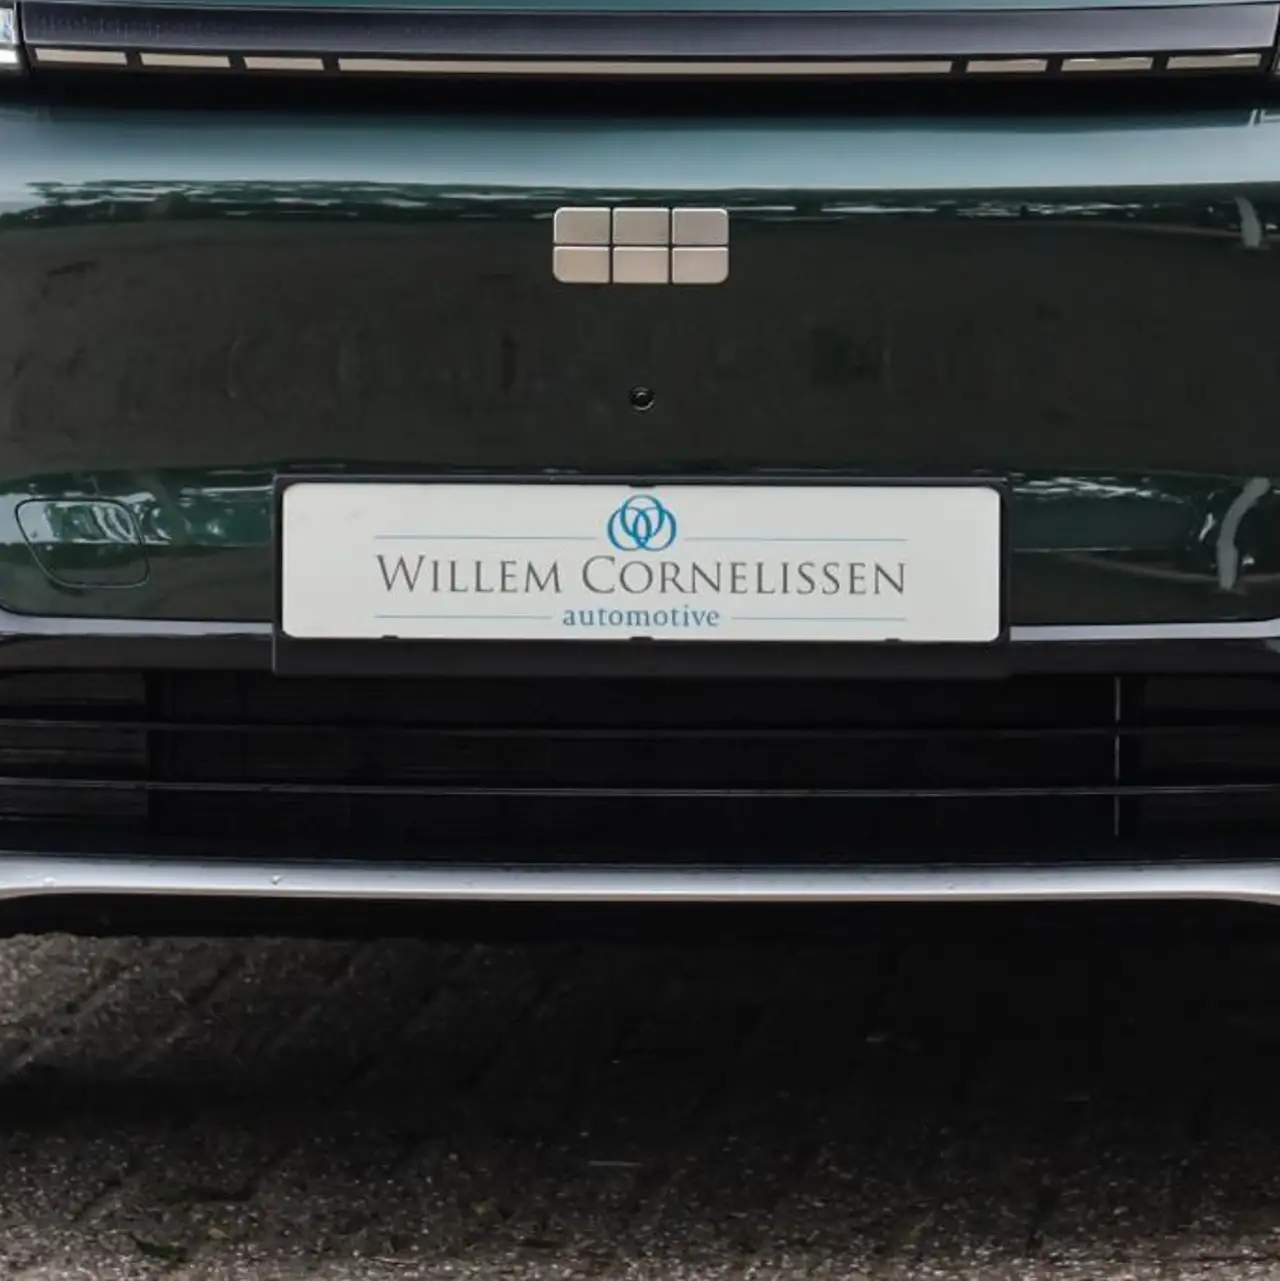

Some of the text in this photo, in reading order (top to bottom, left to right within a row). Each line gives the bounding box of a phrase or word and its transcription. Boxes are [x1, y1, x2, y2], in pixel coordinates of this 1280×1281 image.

[376, 554, 906, 595] WILLEM CORNELISSEN
[562, 604, 721, 628] automotive
